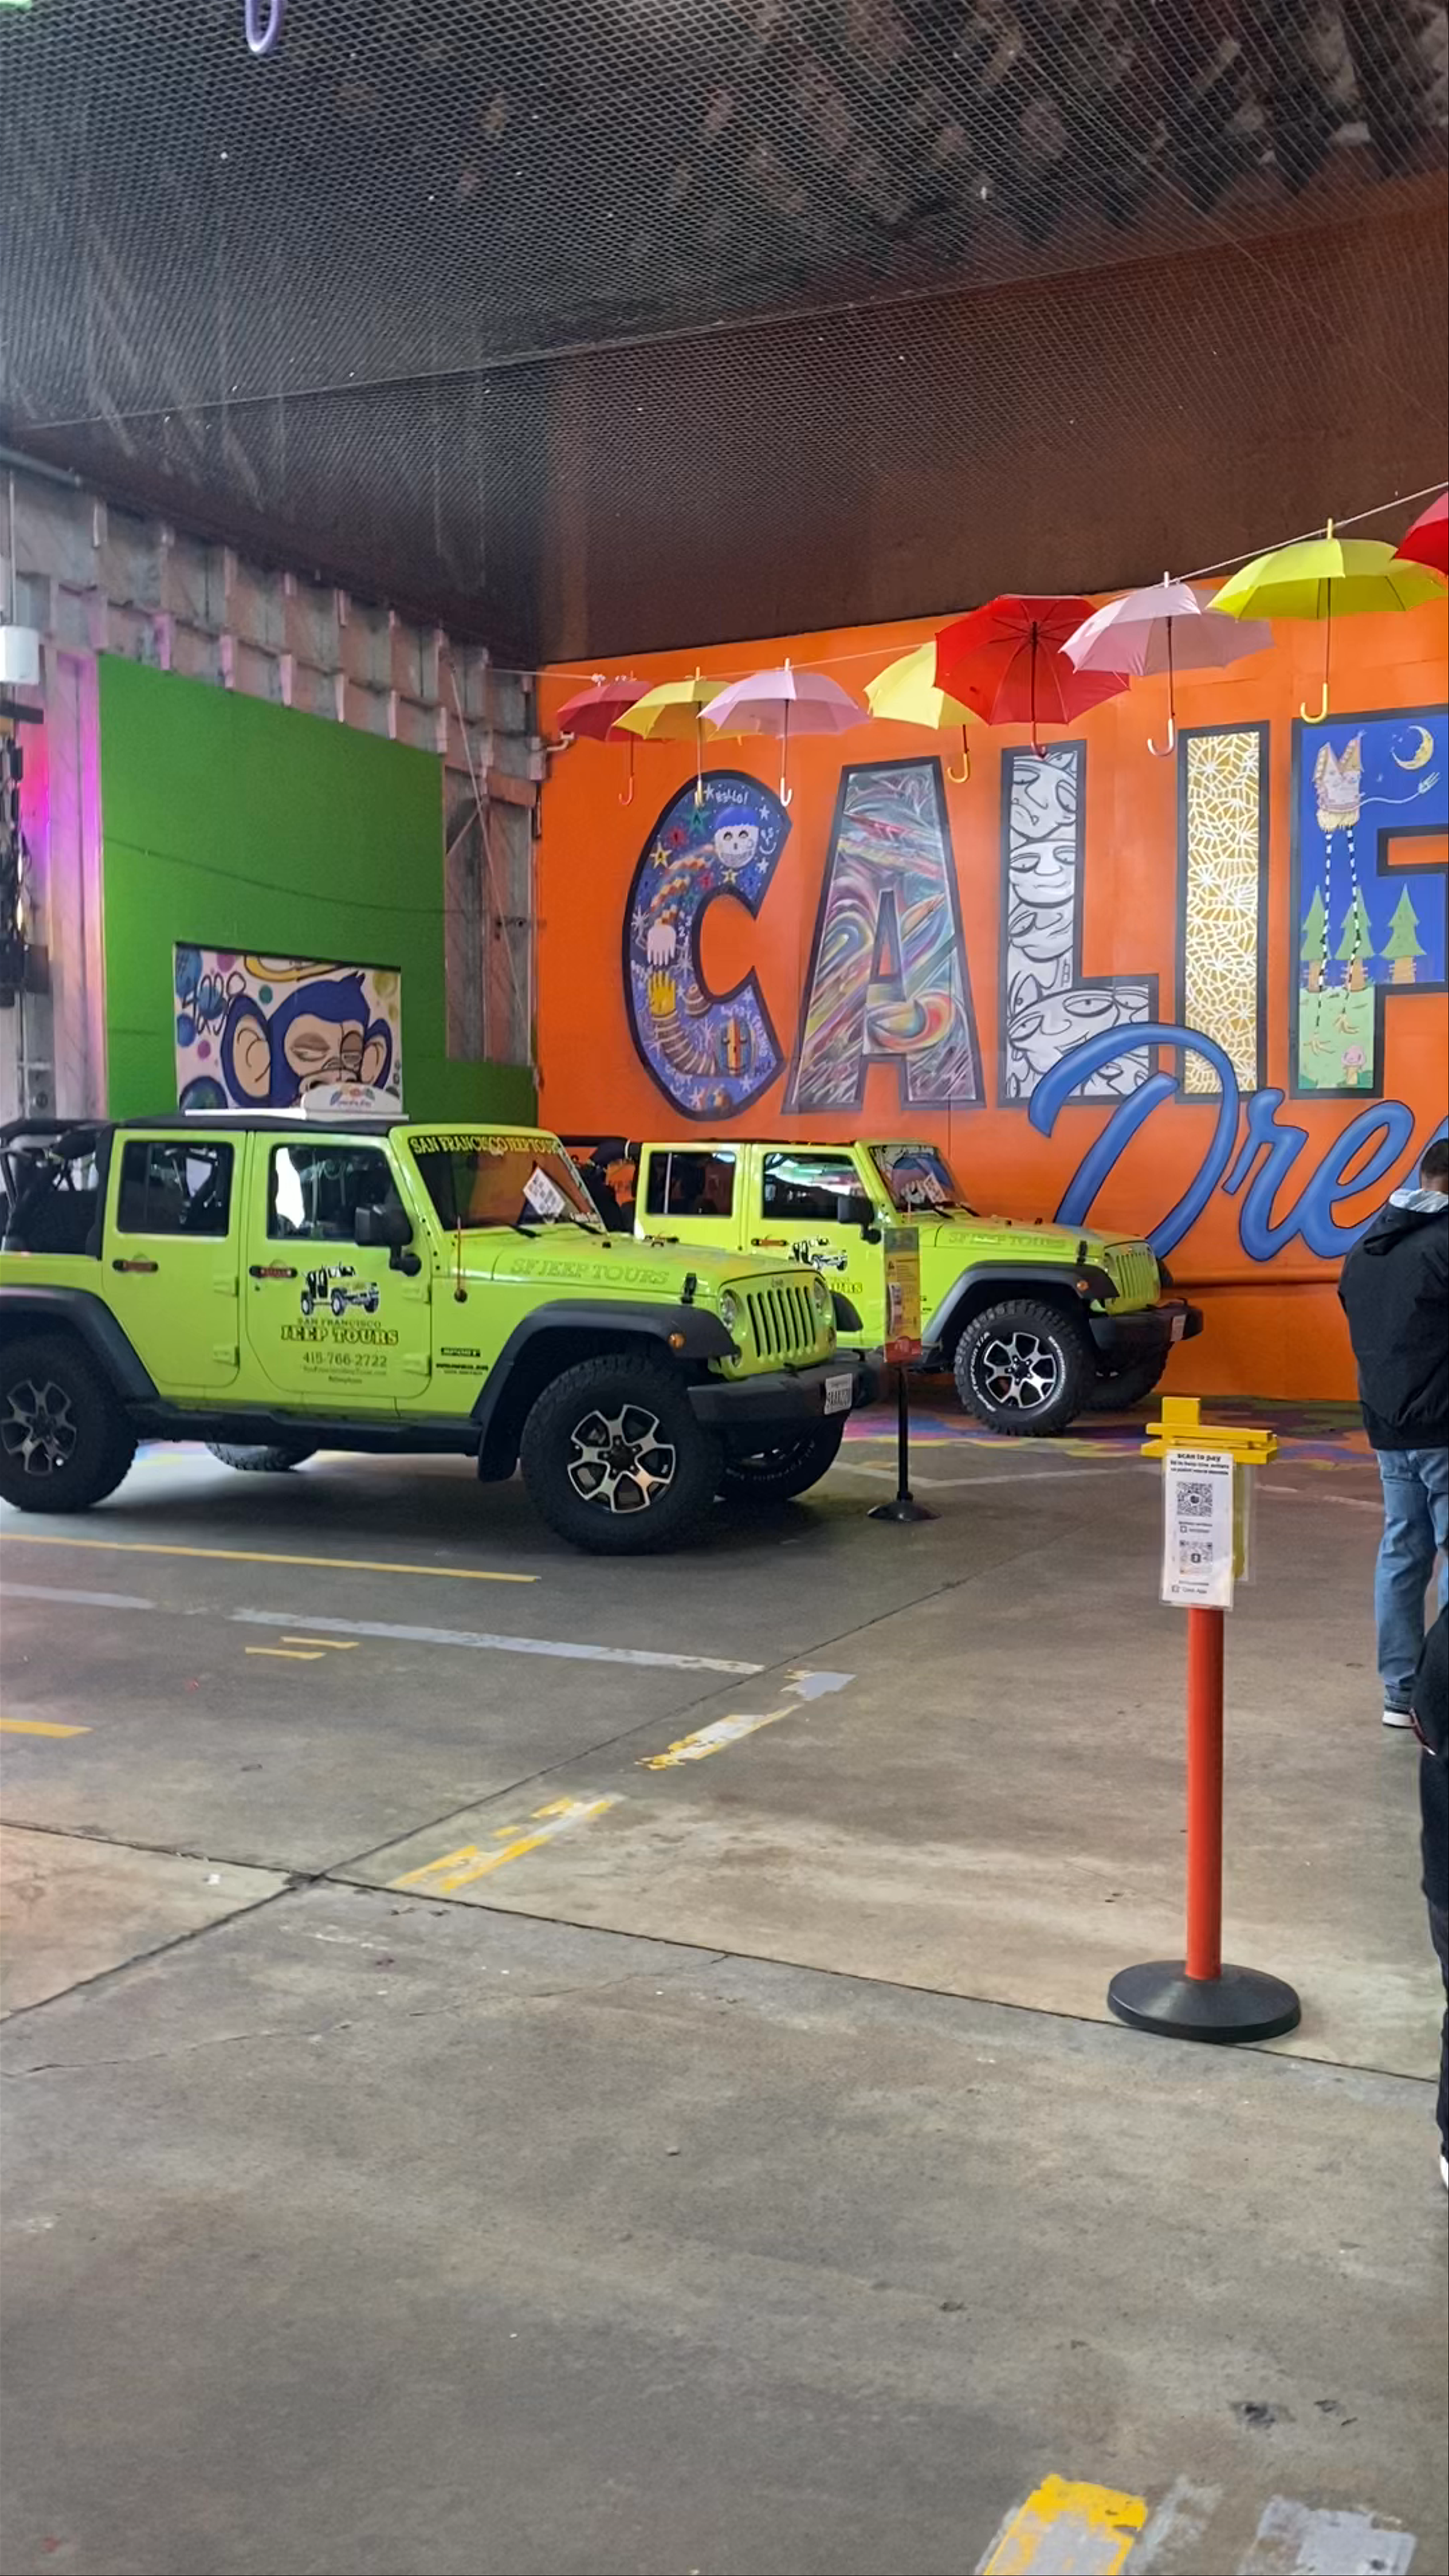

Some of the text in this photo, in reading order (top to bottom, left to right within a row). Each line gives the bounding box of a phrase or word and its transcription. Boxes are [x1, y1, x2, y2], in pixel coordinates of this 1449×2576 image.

[412, 1137, 440, 1154] SAN
[438, 1136, 508, 1155] FRANCISCO
[505, 1137, 531, 1152] JEEP
[1028, 1022, 1449, 1262] Dre
[511, 1258, 670, 1284] SF JEEP TOURS
[320, 1319, 381, 1329] FRANCISCO
[281, 1325, 398, 1346] JEEP TOURS
